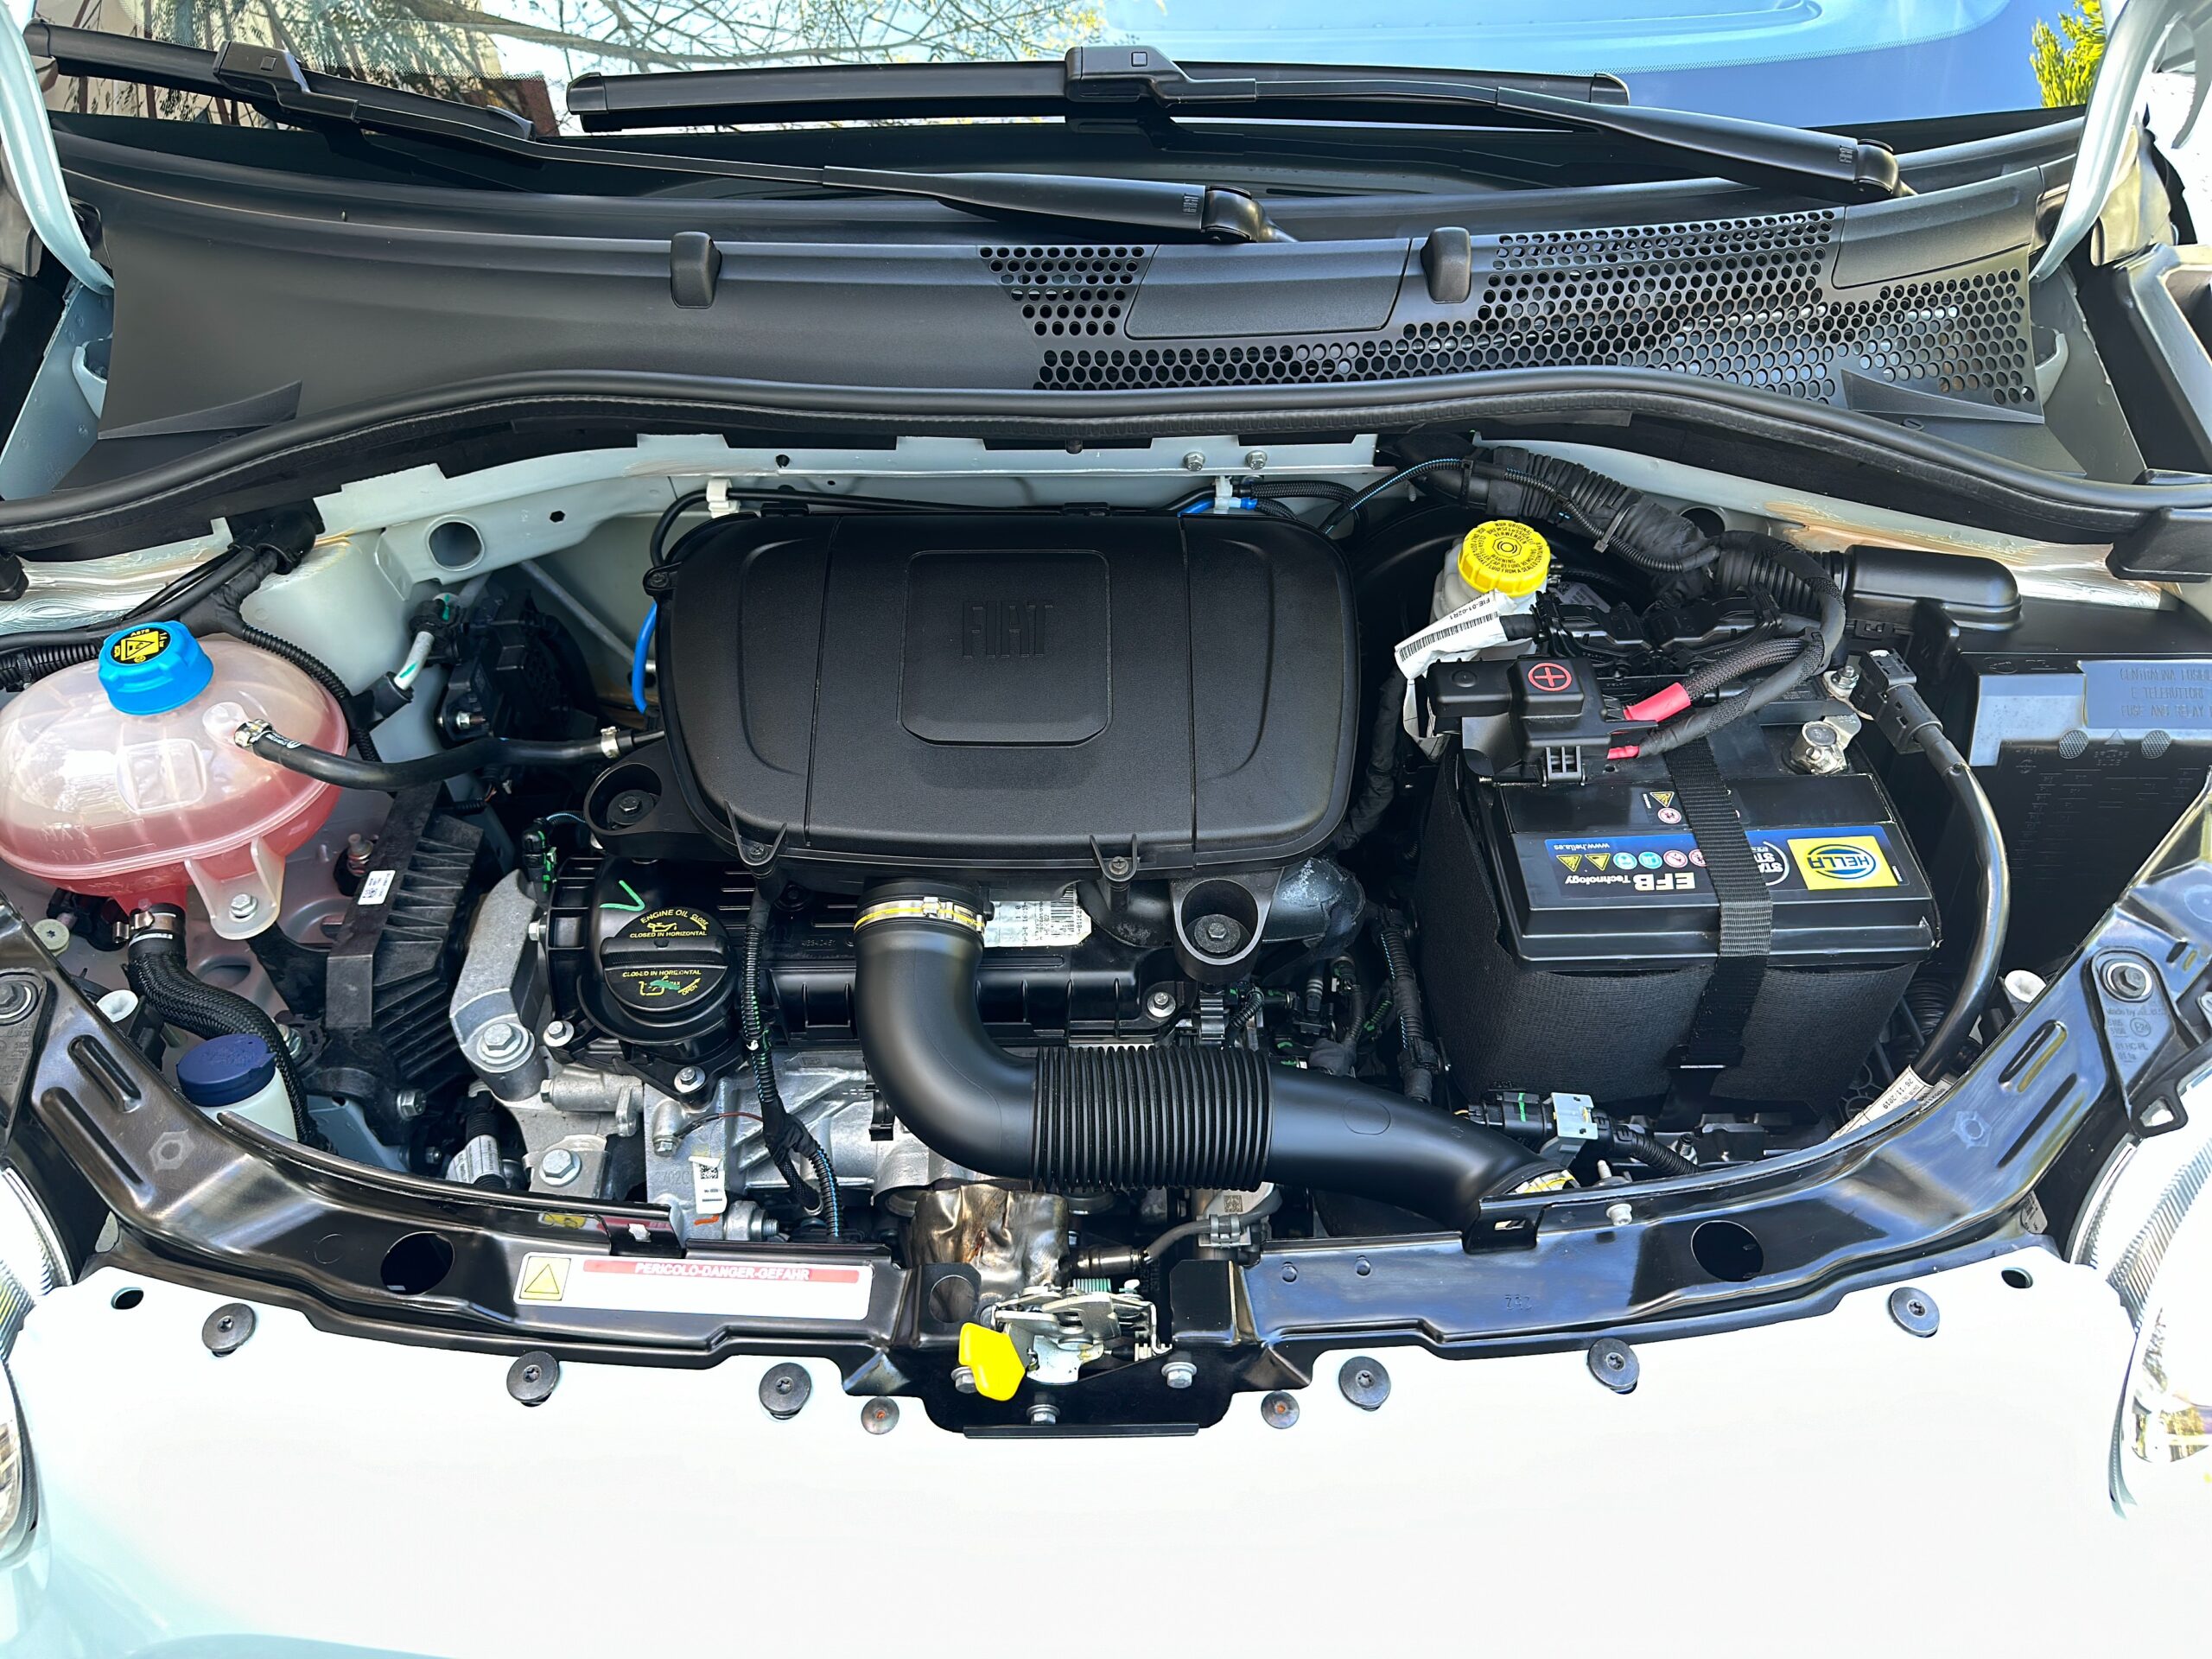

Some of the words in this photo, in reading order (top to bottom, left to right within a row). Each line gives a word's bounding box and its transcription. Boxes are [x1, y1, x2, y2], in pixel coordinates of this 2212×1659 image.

[1508, 523, 1533, 536] ORIGINAL
[1449, 597, 1491, 620] FIE-01-02R1
[962, 600, 1053, 658] FIAT
[2121, 705, 2145, 716] FUSE
[2151, 705, 2171, 716] AND
[2175, 704, 2204, 717] RELAY
[41, 821, 90, 842] MAX
[51, 847, 102, 861] MIN
[1758, 861, 1784, 874] STA
[1806, 855, 1871, 869] HELLA
[1564, 874, 1631, 885] Technology
[1632, 872, 1696, 892] EFB
[640, 909, 675, 924] ENGINE
[675, 909, 689, 918] OIL
[691, 913, 709, 926] CLOSE
[681, 984, 698, 995] OPEN
[1882, 1077, 1914, 1109] 26/11/2019
[634, 1262, 811, 1281] PERICOLO-DANGER-GEFAHR
